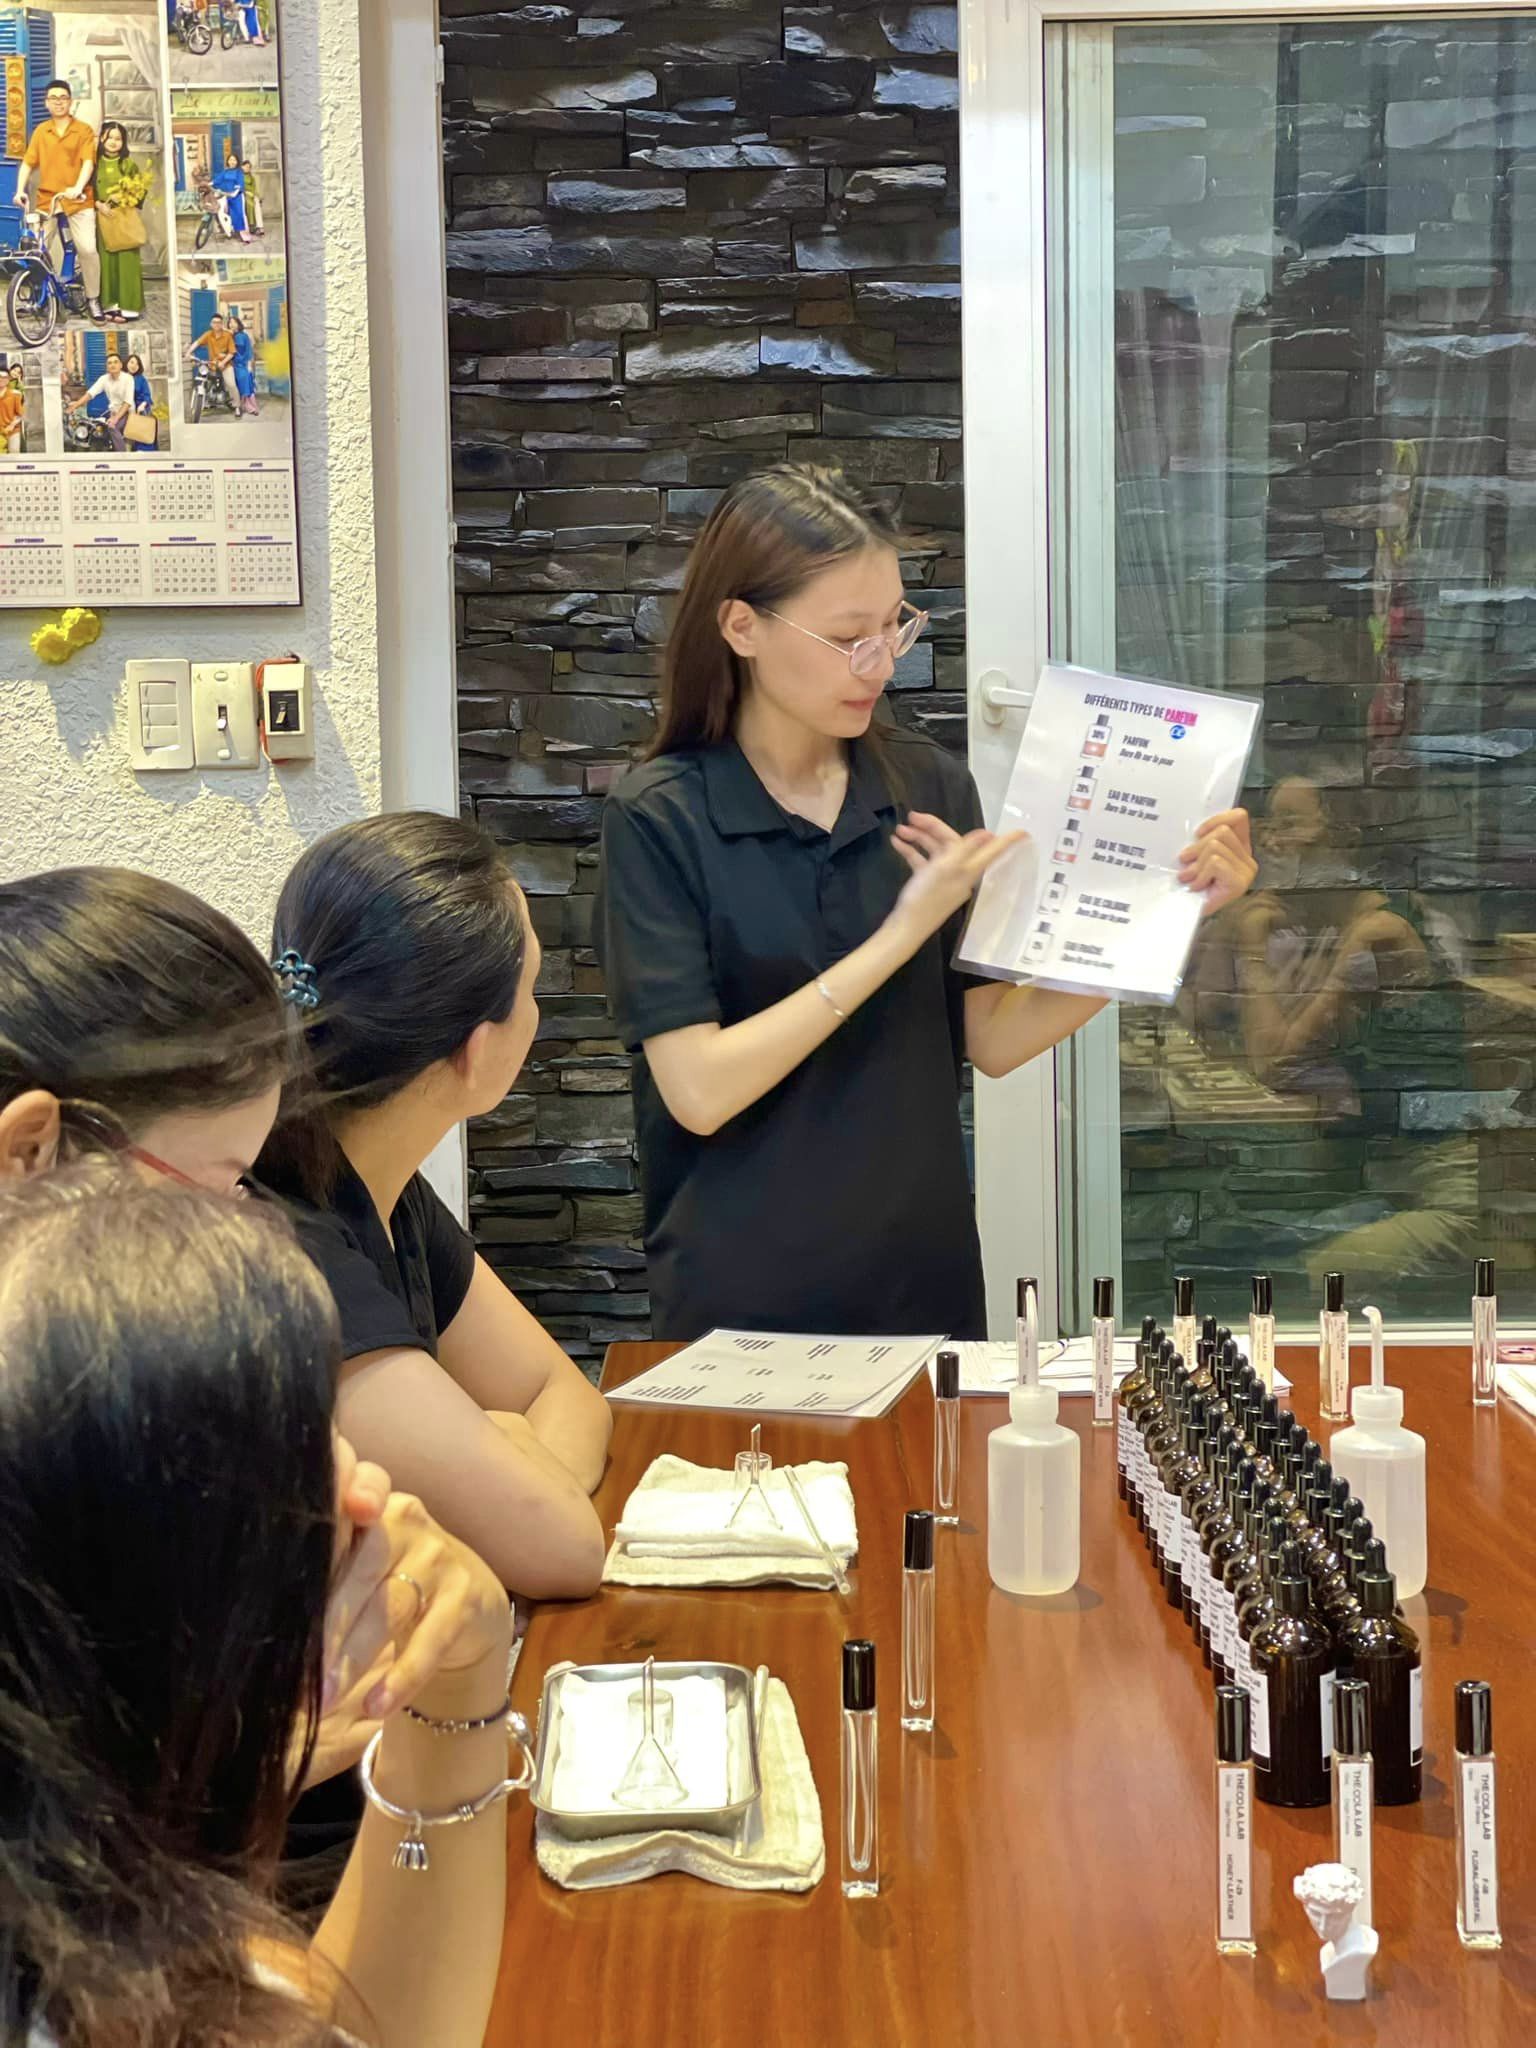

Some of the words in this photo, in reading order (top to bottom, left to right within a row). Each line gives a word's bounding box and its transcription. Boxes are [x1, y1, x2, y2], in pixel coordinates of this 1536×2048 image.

[1084, 693, 1128, 711] DIFFÉRENTS
[1130, 702, 1153, 716] TYPES
[1154, 706, 1165, 718] DE
[1165, 708, 1198, 726] PARFUM
[1122, 735, 1151, 748] PARFUM
[1119, 748, 1134, 758] Dure
[1108, 789, 1120, 800] EAU
[1121, 792, 1131, 802] DE
[1131, 794, 1157, 808] PARFUM
[1354, 1818, 1362, 1837] LAB
[1483, 1822, 1491, 1840] LAB
